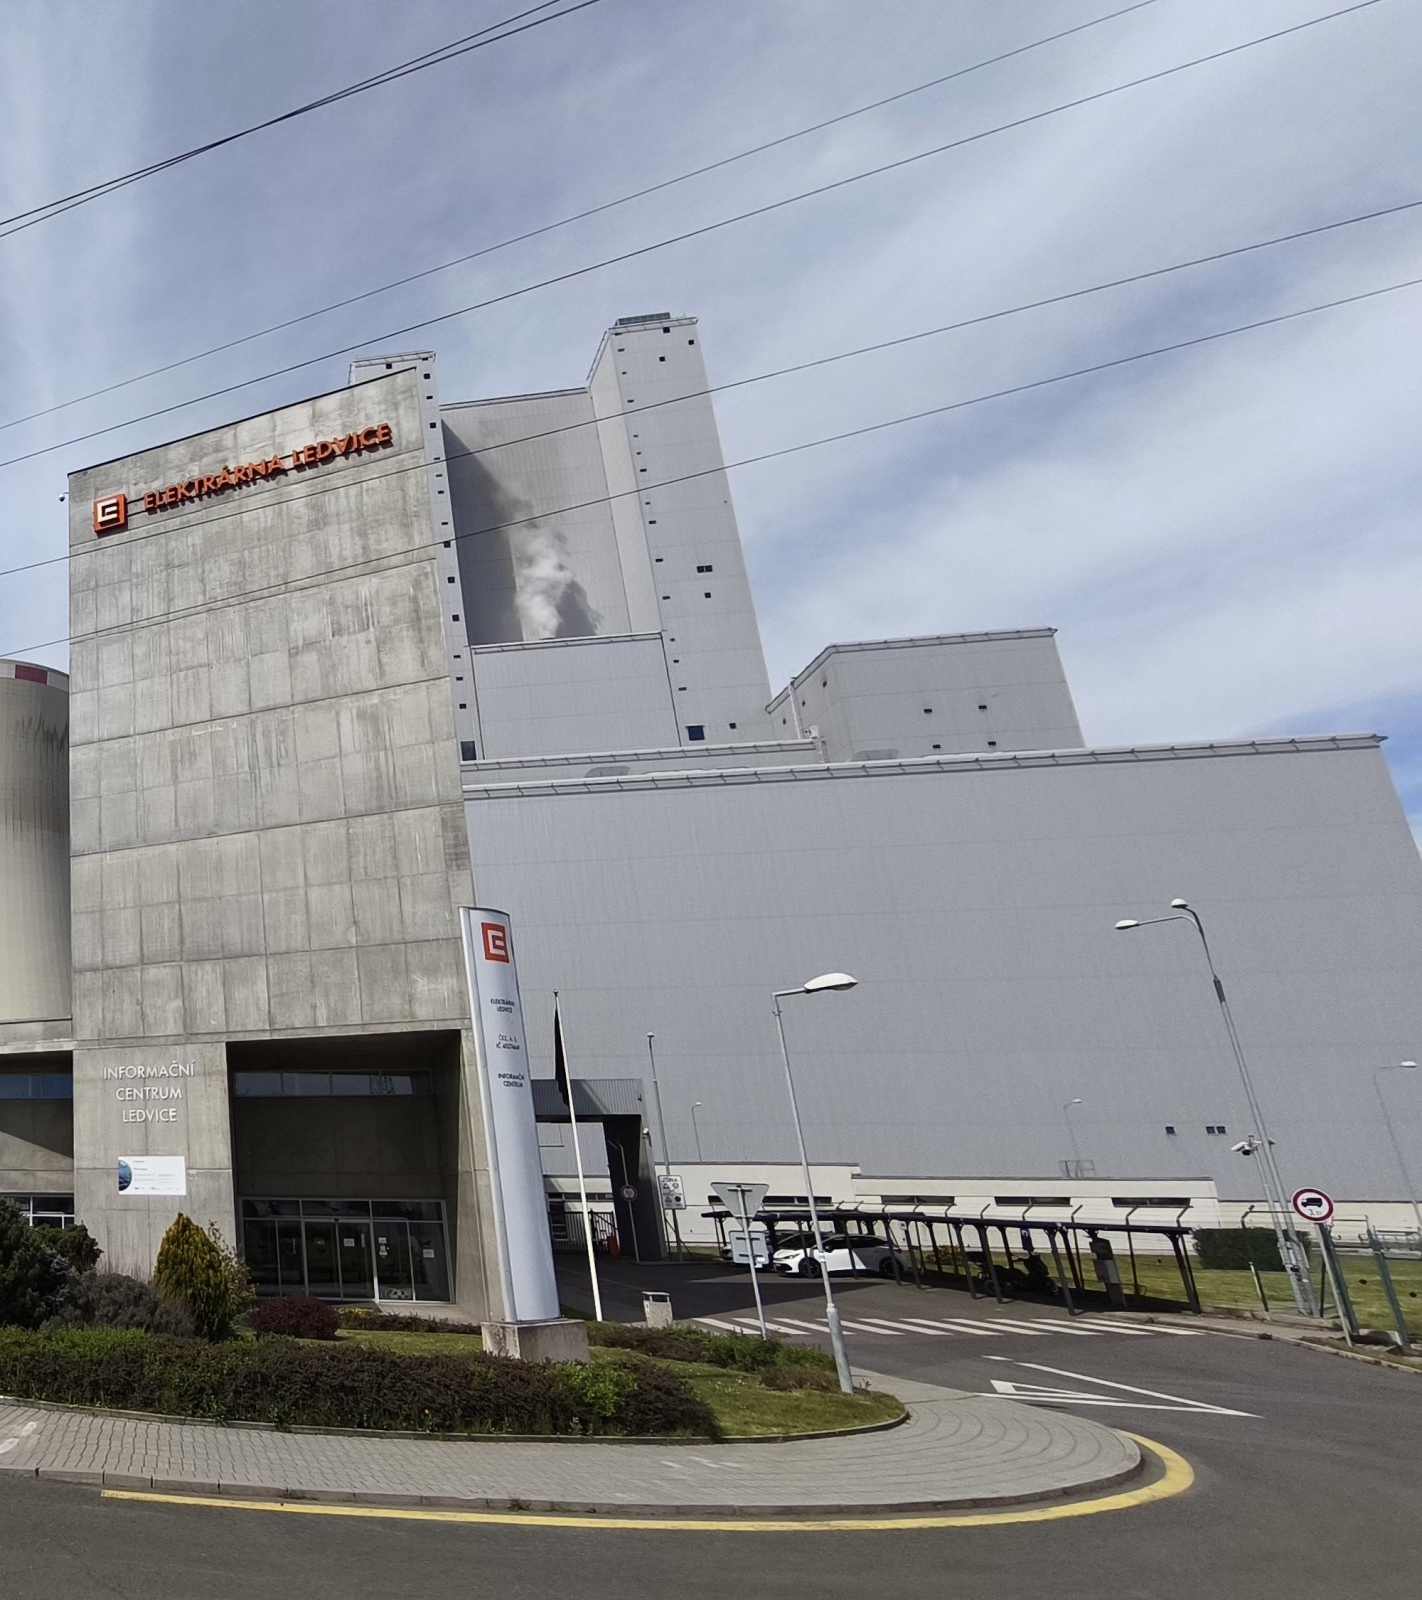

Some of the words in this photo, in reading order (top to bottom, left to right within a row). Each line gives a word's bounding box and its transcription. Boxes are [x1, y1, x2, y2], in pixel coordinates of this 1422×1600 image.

[142, 454, 286, 512] ELEKTRÁRNA
[292, 422, 393, 467] LEDVICE
[103, 1060, 195, 1080] INFORMAČNÍ
[115, 1086, 183, 1101] CENTRUM
[122, 1107, 178, 1123] LEDVICE
